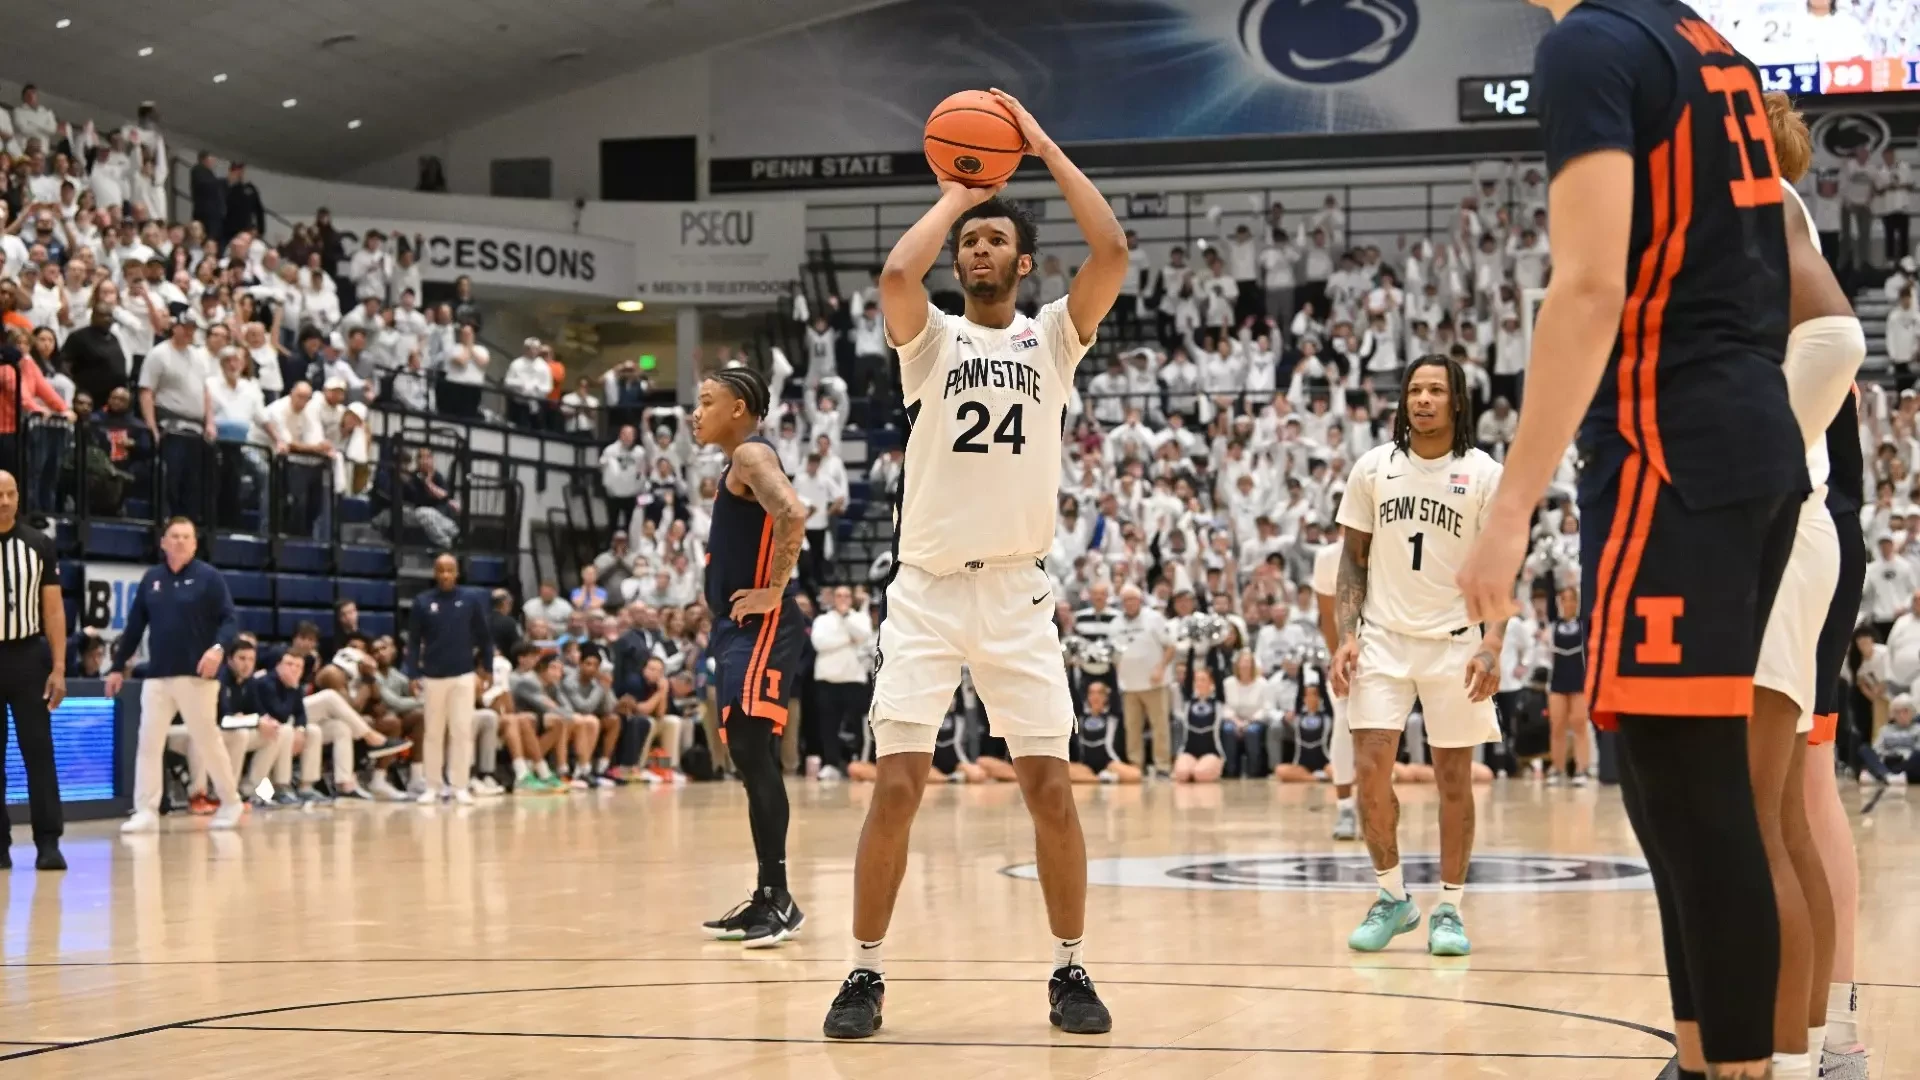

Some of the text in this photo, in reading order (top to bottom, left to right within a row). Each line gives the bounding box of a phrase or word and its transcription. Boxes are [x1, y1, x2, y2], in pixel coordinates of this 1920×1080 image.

[1483, 80, 1529, 114] 42
[1700, 65, 1784, 208] 33
[751, 155, 893, 179] PENN STATE
[681, 210, 754, 247] PSECU
[338, 231, 595, 281] CNCESSIONS
[943, 358, 1041, 405] PENN STATE
[952, 401, 1026, 454] 24
[1380, 496, 1463, 538] PENN STATE
[964, 561, 985, 569] PSU
[1408, 532, 1424, 571] 1
[1635, 596, 1684, 665] I
[766, 668, 782, 700] I
